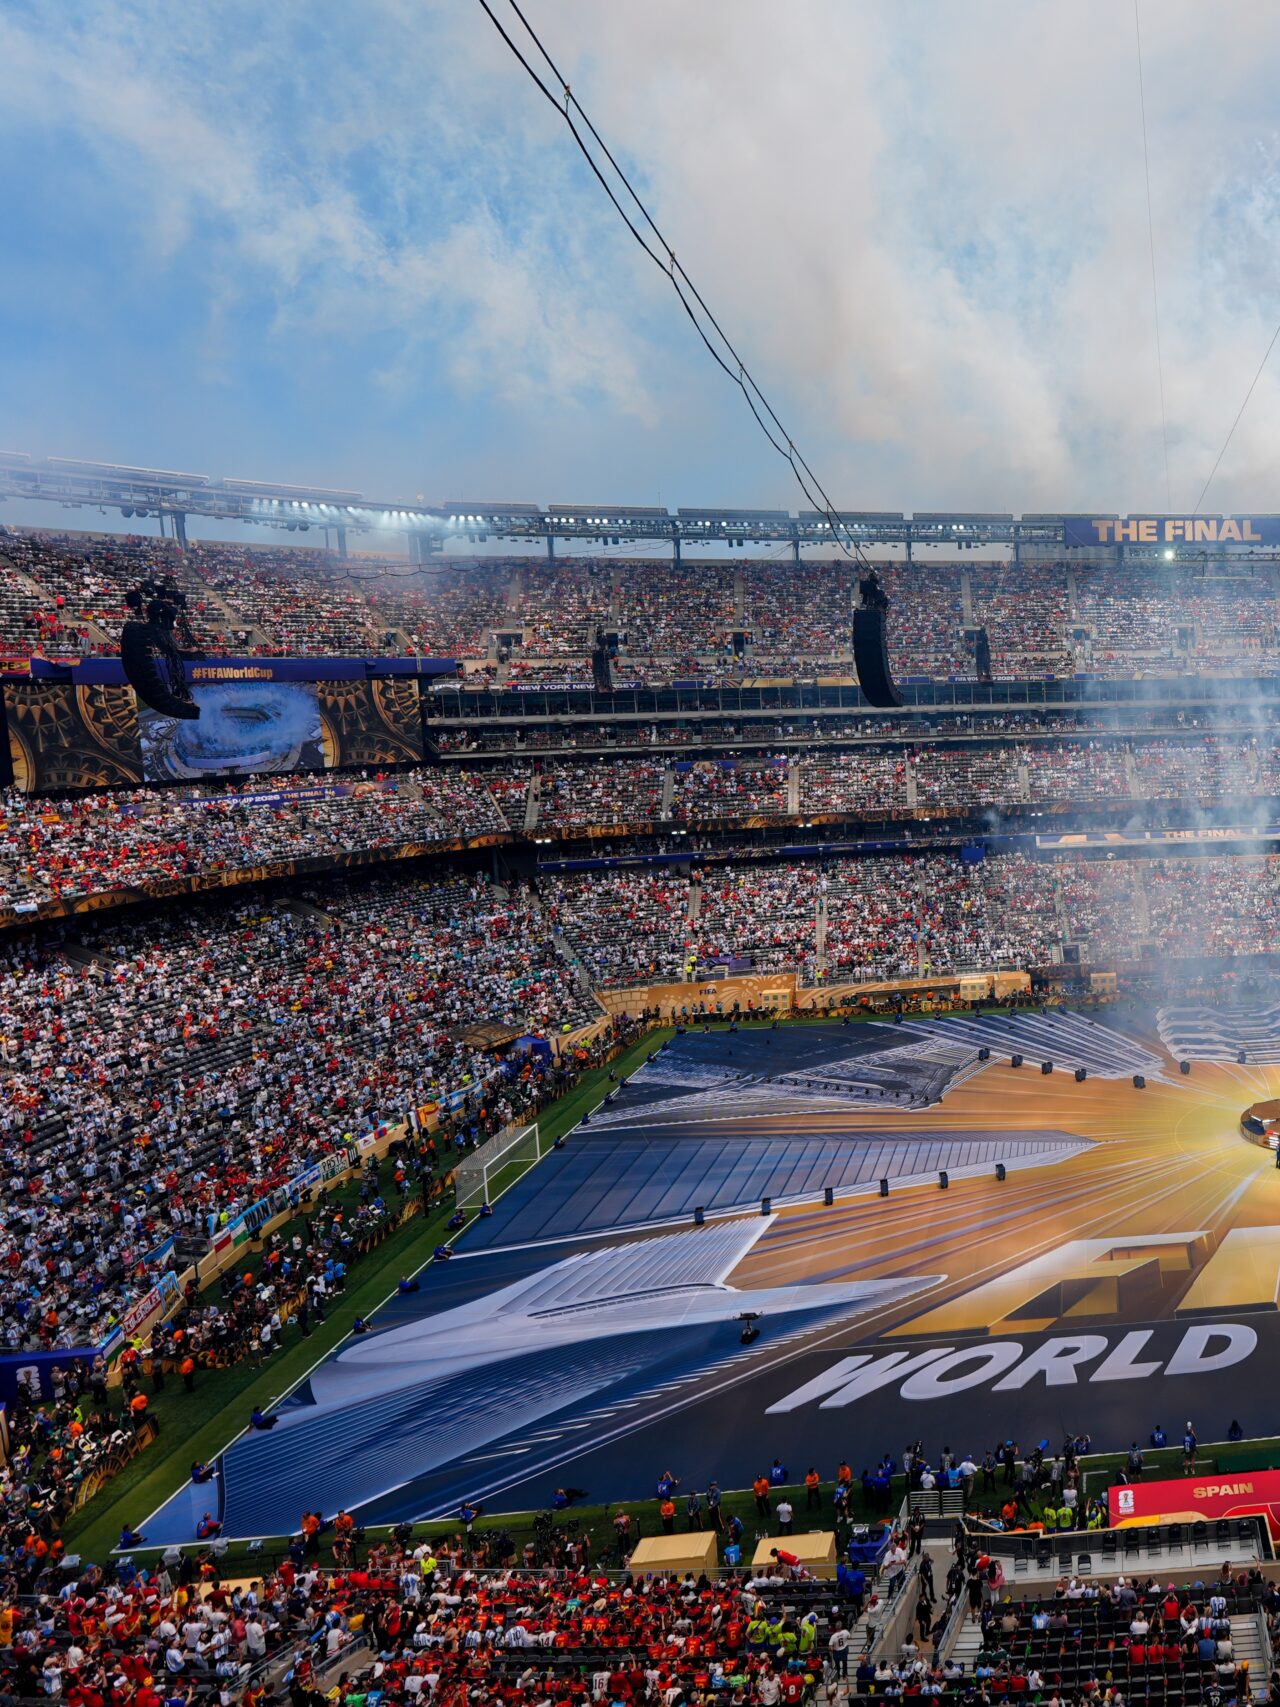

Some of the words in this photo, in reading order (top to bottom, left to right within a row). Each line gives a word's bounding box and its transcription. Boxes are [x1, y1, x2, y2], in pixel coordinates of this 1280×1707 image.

[1091, 519, 1158, 542] THE
[1164, 519, 1262, 542] FINAL
[192, 666, 273, 679] #FIFAWorldCup
[254, 795, 280, 803] 2026
[300, 790, 324, 798] FINAL
[1162, 830, 1195, 839] THE
[764, 1323, 1258, 1415] WORLD
[1193, 1482, 1254, 1499] SPAIN
[512, 1630, 521, 1641] 10
[730, 1631, 737, 1641] 6
[838, 1638, 844, 1647] 6
[594, 1678, 604, 1690] 16
[789, 1684, 796, 1695] 8
